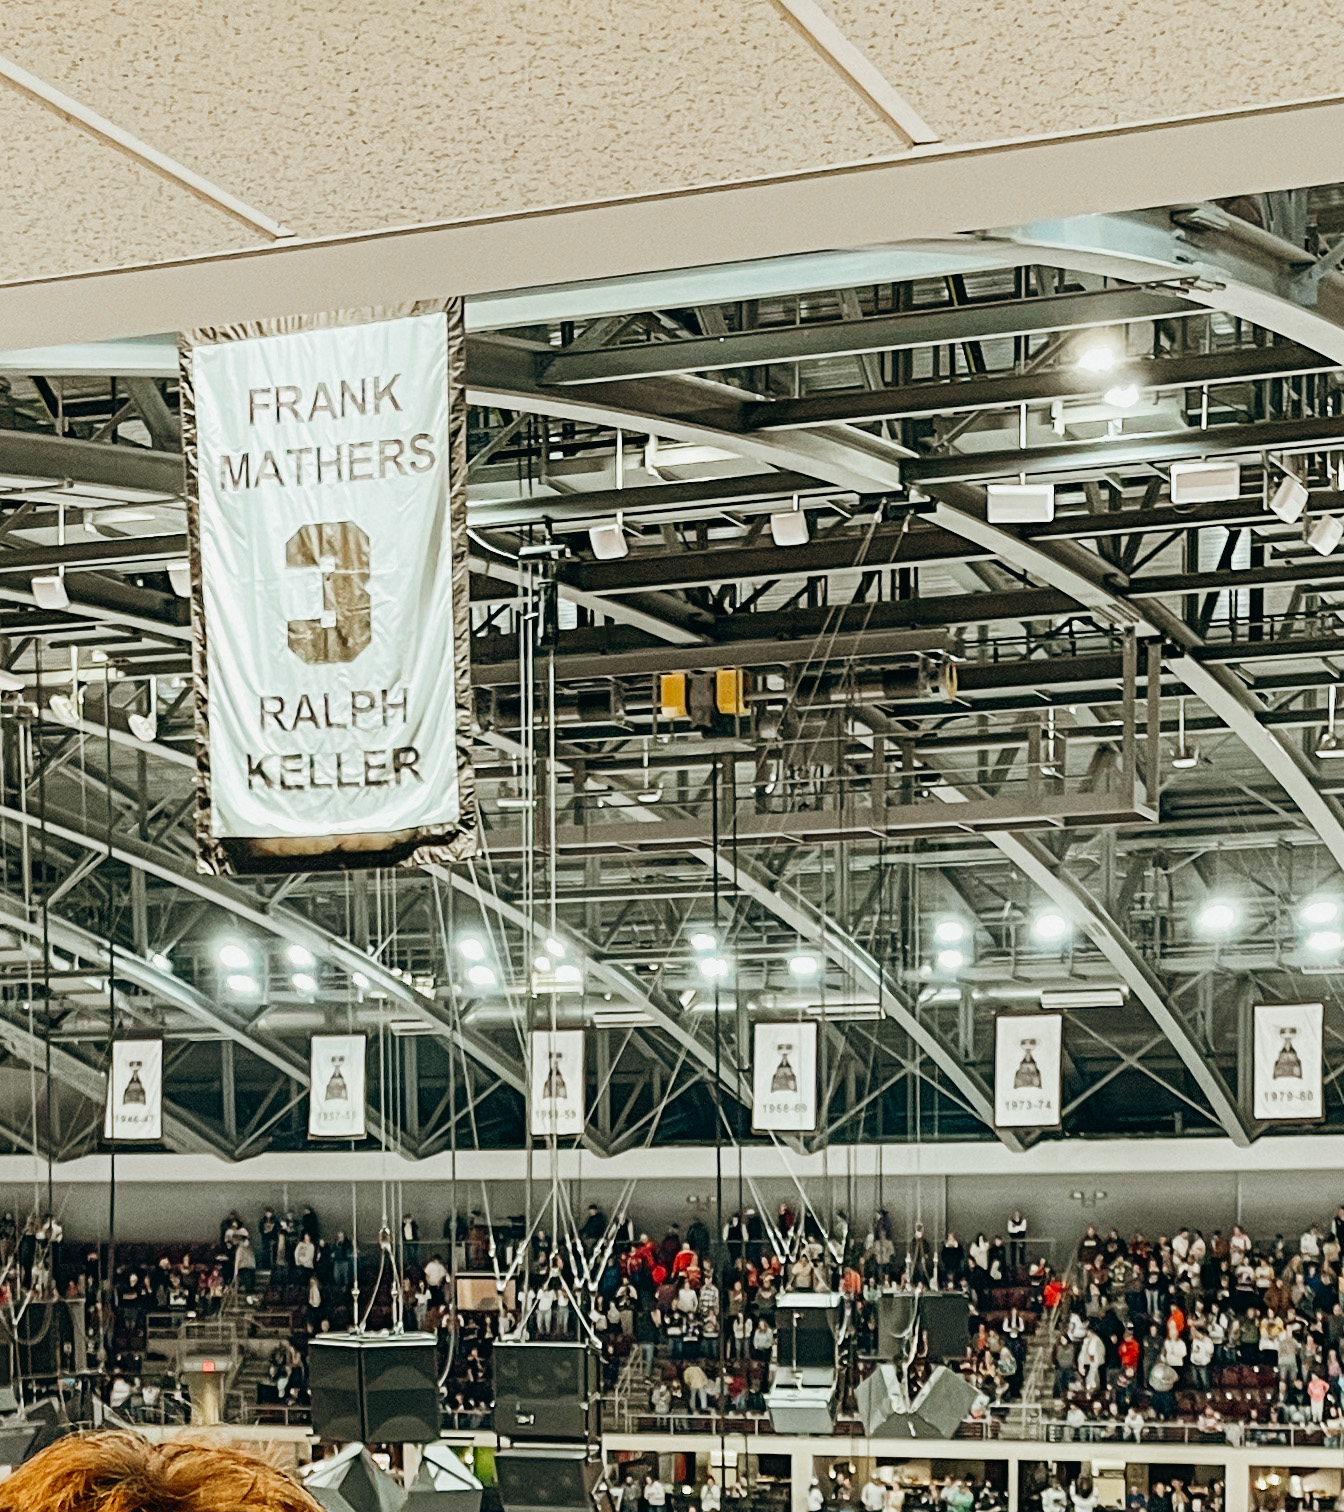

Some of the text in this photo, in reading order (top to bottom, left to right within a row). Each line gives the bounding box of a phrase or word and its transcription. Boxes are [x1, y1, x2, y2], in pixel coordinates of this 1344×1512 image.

[248, 374, 403, 425] FRANK
[220, 433, 436, 491] MATHERS
[285, 520, 371, 665] 3
[260, 688, 408, 733] RALPH
[246, 745, 425, 791] KELLER
